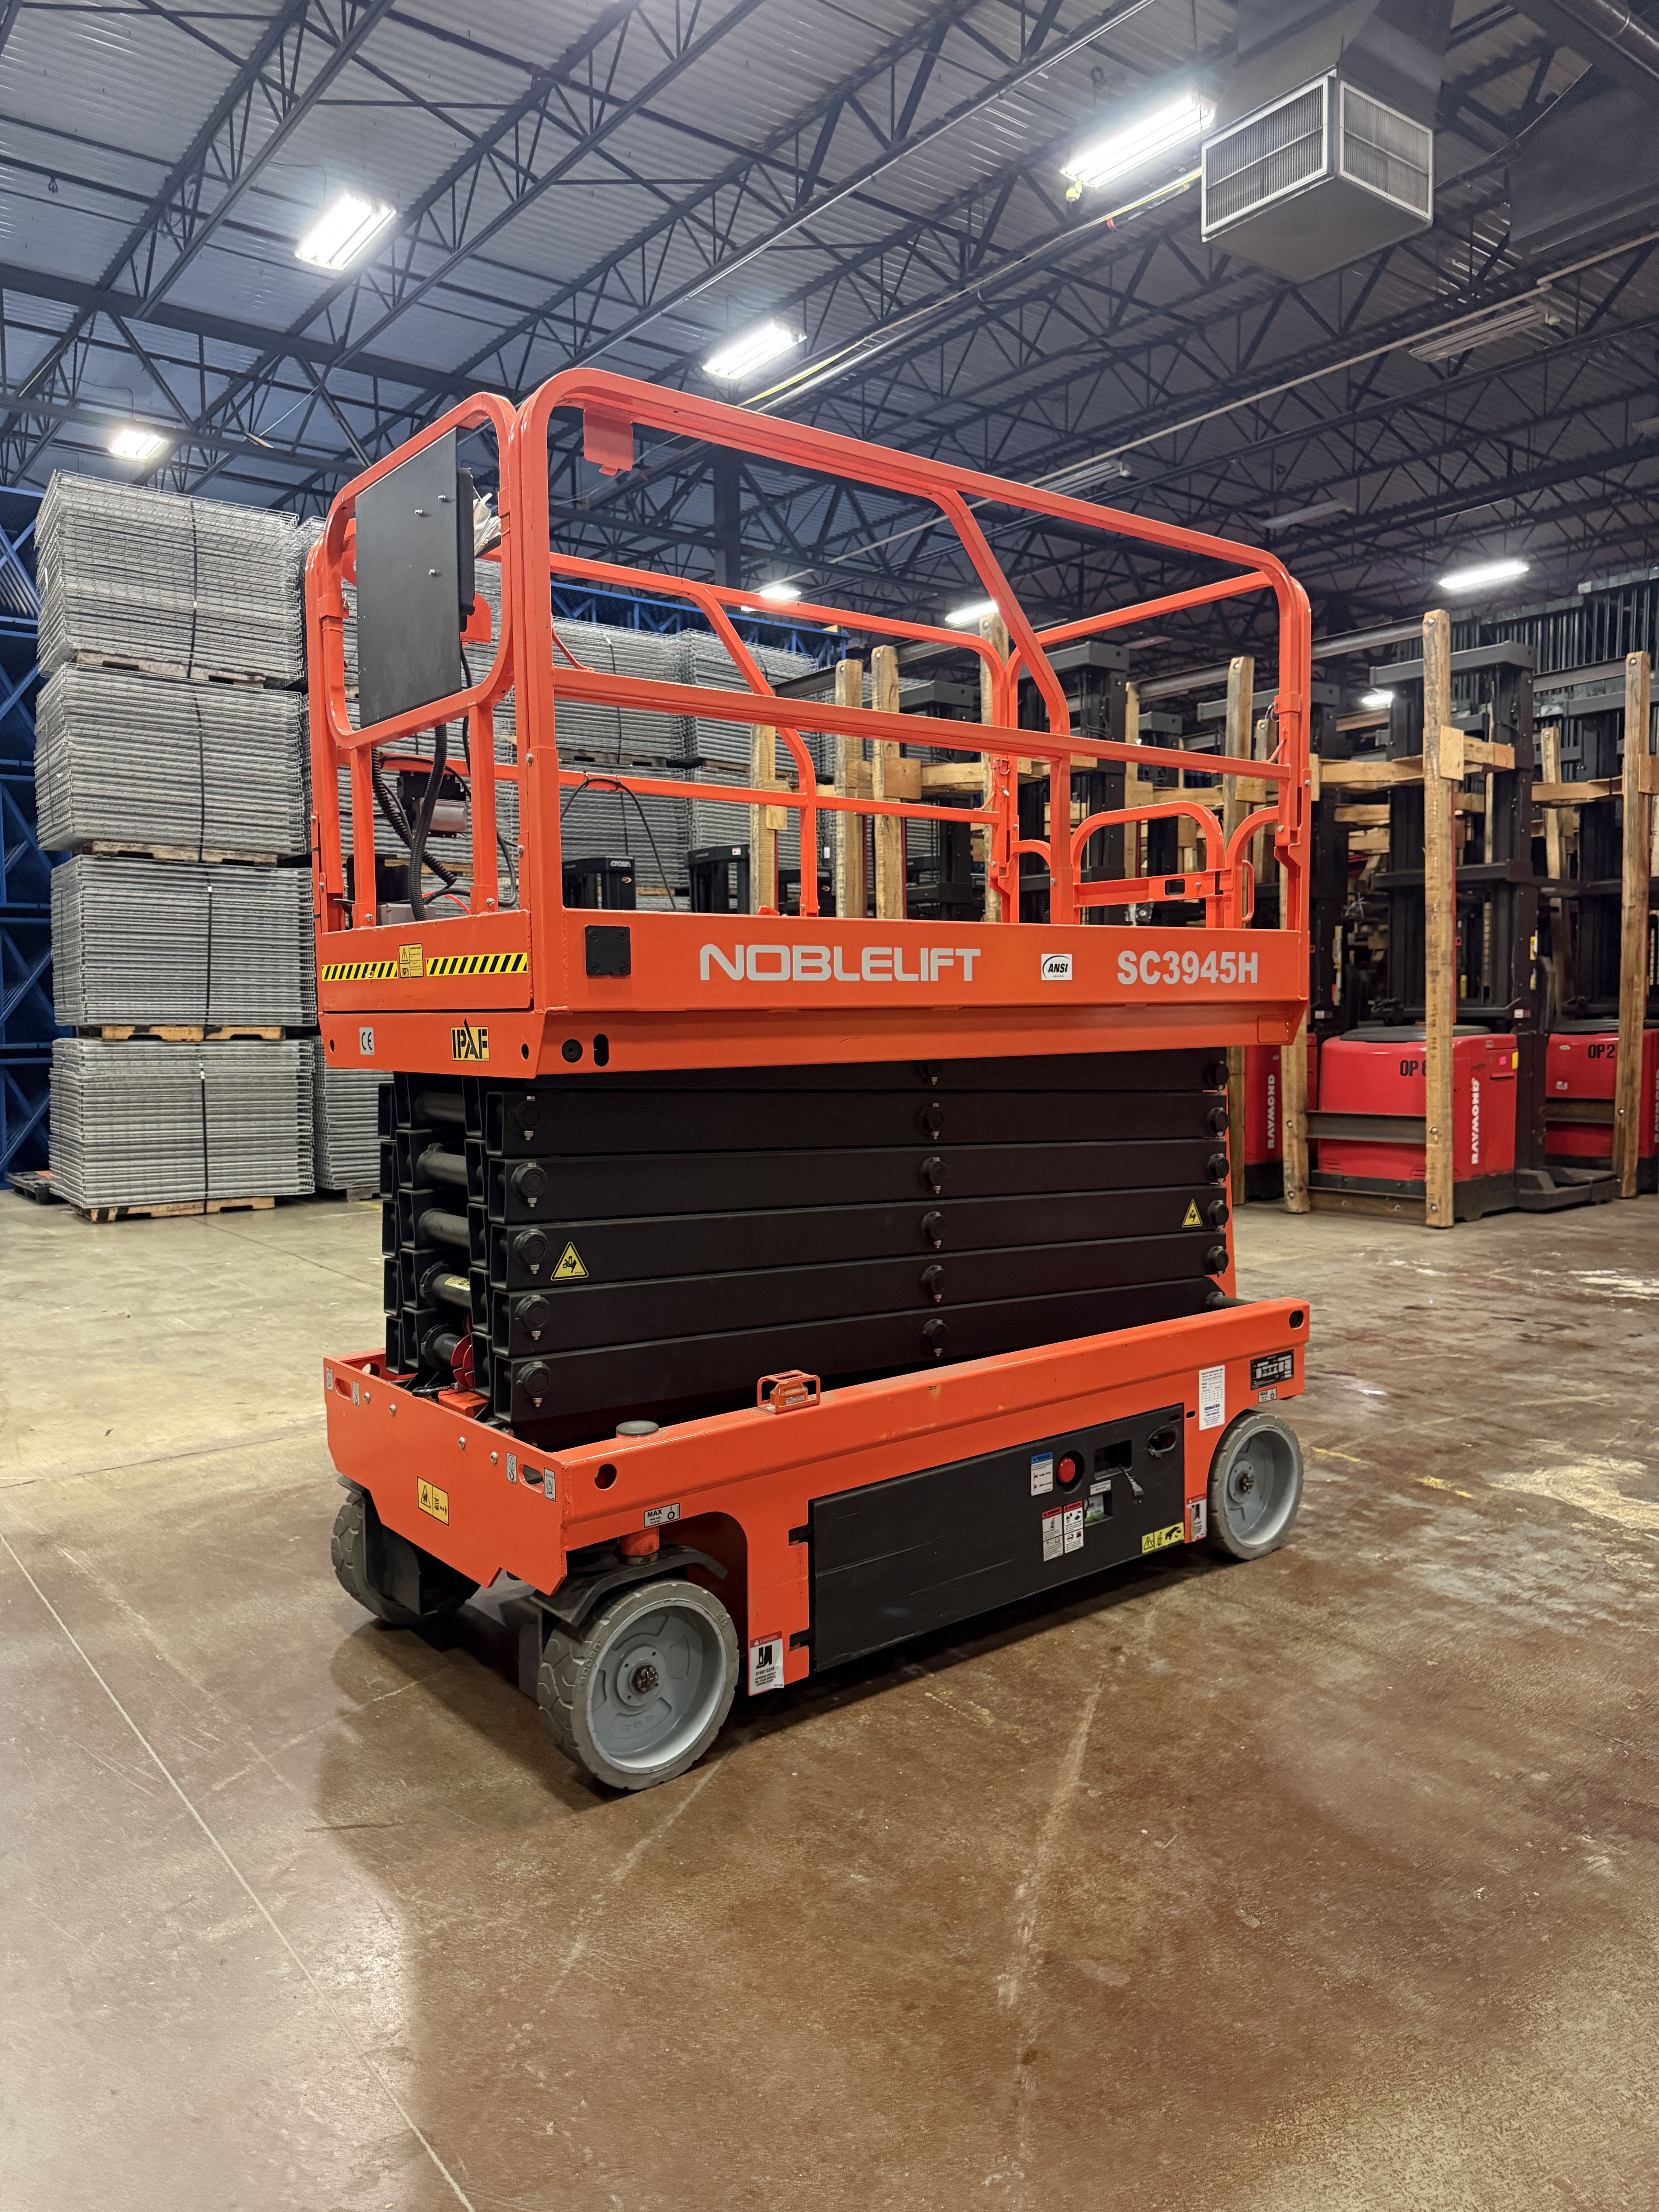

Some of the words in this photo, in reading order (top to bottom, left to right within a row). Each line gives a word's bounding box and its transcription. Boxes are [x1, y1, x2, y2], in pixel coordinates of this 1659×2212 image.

[700, 944, 981, 982] NOBLELIFT
[1048, 963, 1068, 973] ANSI
[1117, 950, 1258, 985] SC3945H
[361, 1032, 373, 1051] CE
[452, 1017, 488, 1059] IPAF
[1588, 1044, 1605, 1058] OP
[1606, 1044, 1615, 1058] 2
[1399, 1060, 1419, 1077] OP
[1267, 1074, 1275, 1149] RAYMOND
[1471, 1078, 1480, 1165] RAYMOND
[647, 1509, 662, 1518] MAX
[759, 1634, 778, 1644] DANGER
